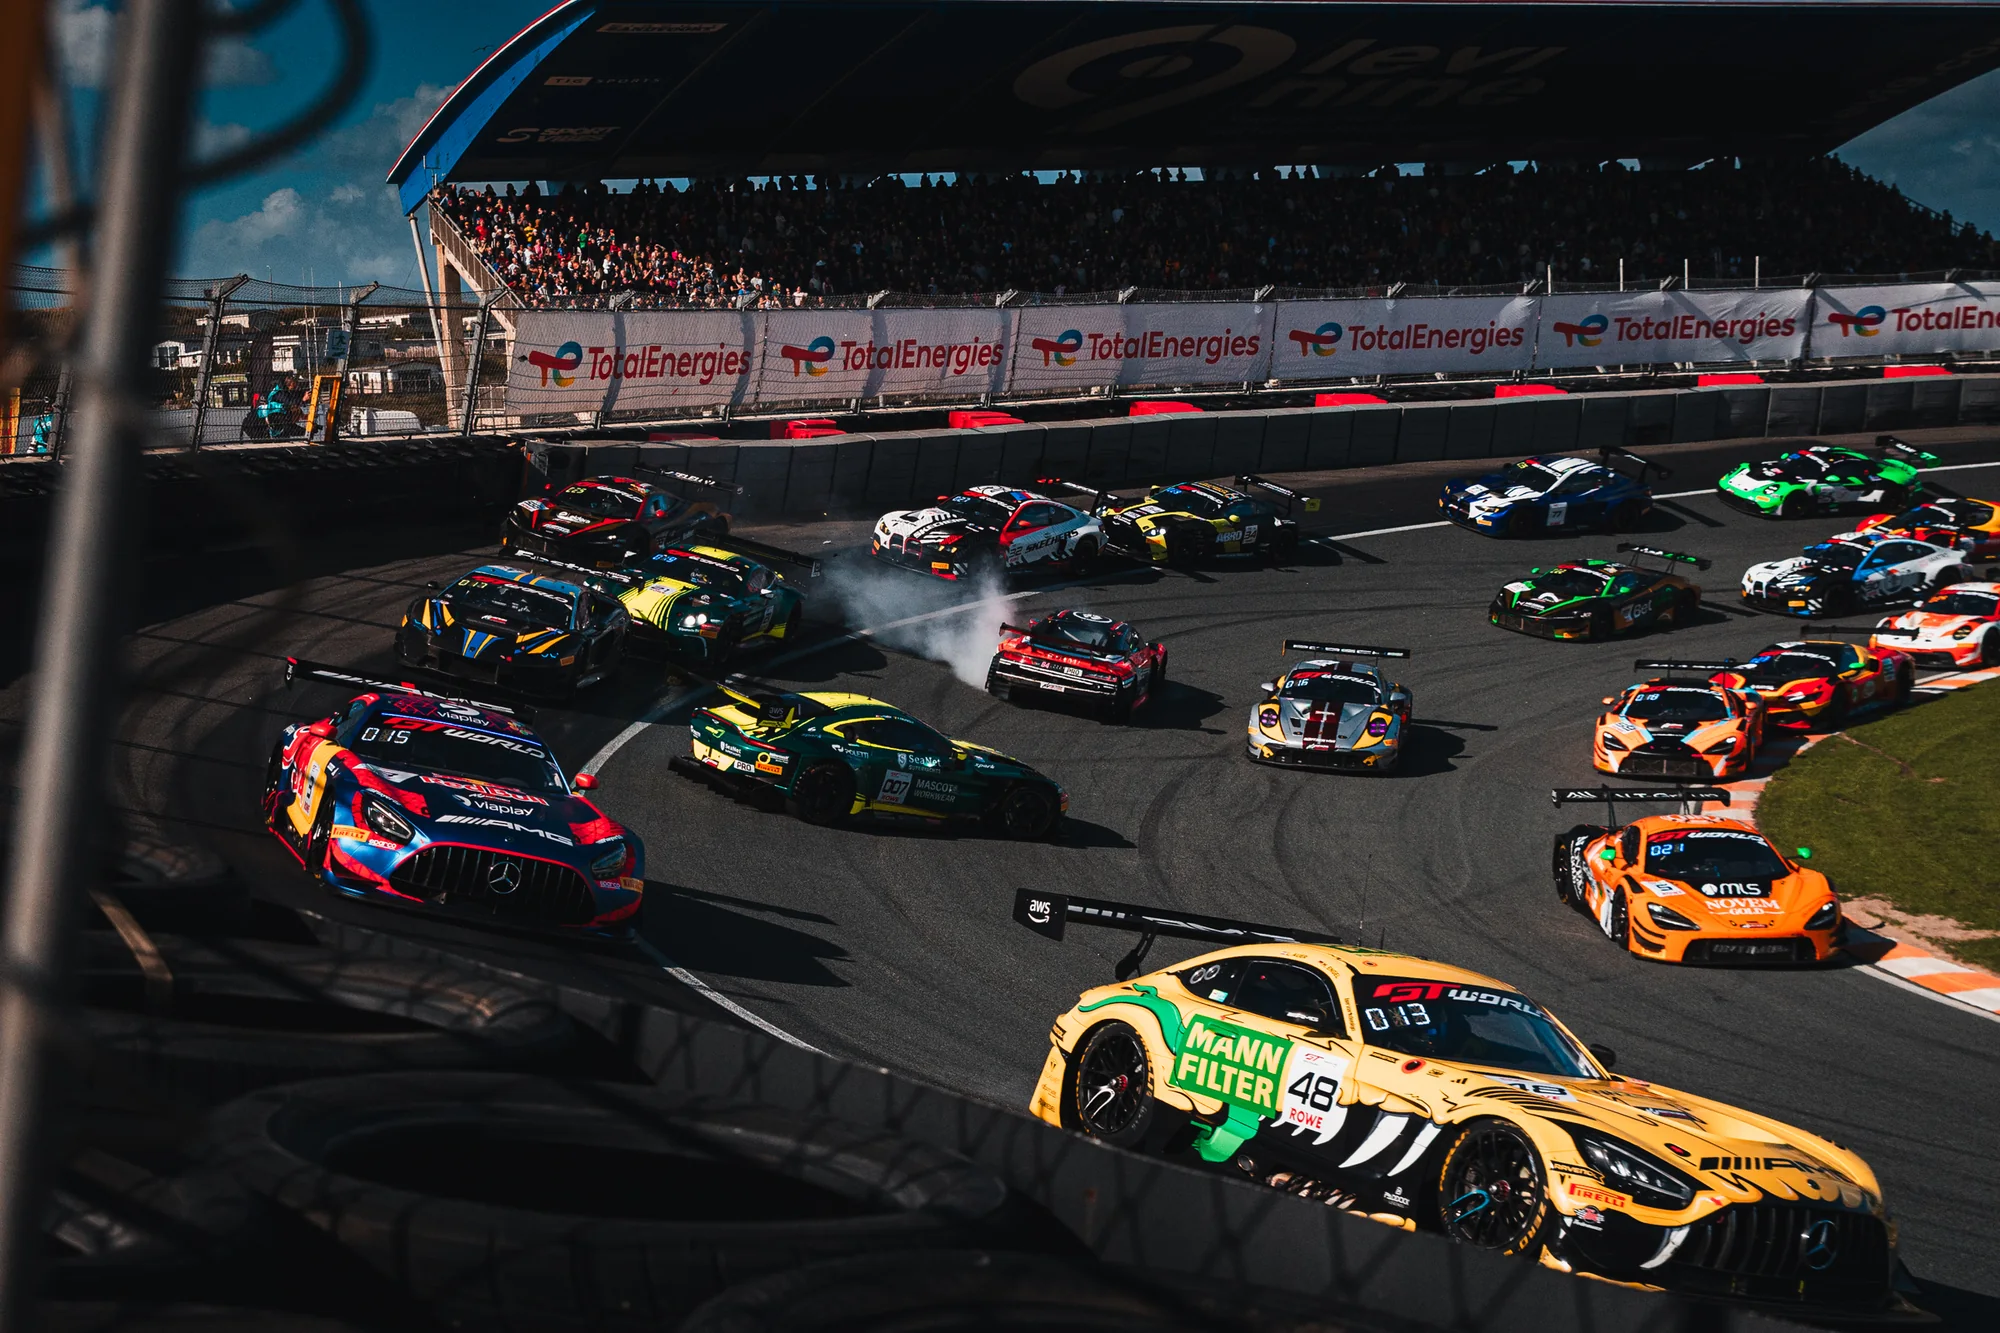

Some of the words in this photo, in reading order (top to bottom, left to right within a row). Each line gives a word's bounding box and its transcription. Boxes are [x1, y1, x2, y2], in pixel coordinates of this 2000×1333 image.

[1613, 312, 1796, 346] TotalEnergies
[1348, 320, 1525, 355] TotalEnergies
[1087, 328, 1261, 364] TotalEnergies
[587, 340, 752, 386] TotalEnergies
[840, 335, 1004, 375] TotalEnergies
[1025, 529, 1079, 554] SKECHERS
[1215, 530, 1243, 543] ABRO
[769, 706, 784, 715] aws
[437, 711, 490, 727] viaplay
[361, 726, 412, 745] 015
[383, 716, 448, 733] GT
[443, 728, 545, 759] WORLD
[736, 761, 752, 771] PRO
[908, 753, 942, 768] SeaNet
[882, 778, 910, 794] 007
[913, 789, 956, 803] WORKWEAR
[474, 800, 535, 816] viaplay
[333, 827, 366, 839] PIRELLI
[1649, 829, 1701, 843] GT
[368, 839, 397, 850] sparco
[1719, 882, 1762, 896] mls
[1029, 899, 1051, 914] aws
[1705, 898, 1781, 911] NOVEM
[1729, 907, 1765, 916] GOLD
[1373, 982, 1461, 1002] GT
[1365, 1002, 1431, 1031] 013
[1185, 1021, 1285, 1075] MANN
[1304, 1053, 1324, 1062] GT
[1177, 1055, 1276, 1109] FILTER
[1288, 1072, 1339, 1113] 48
[1289, 1107, 1324, 1130] ROWE
[1568, 1183, 1626, 1208] PIRELLI
